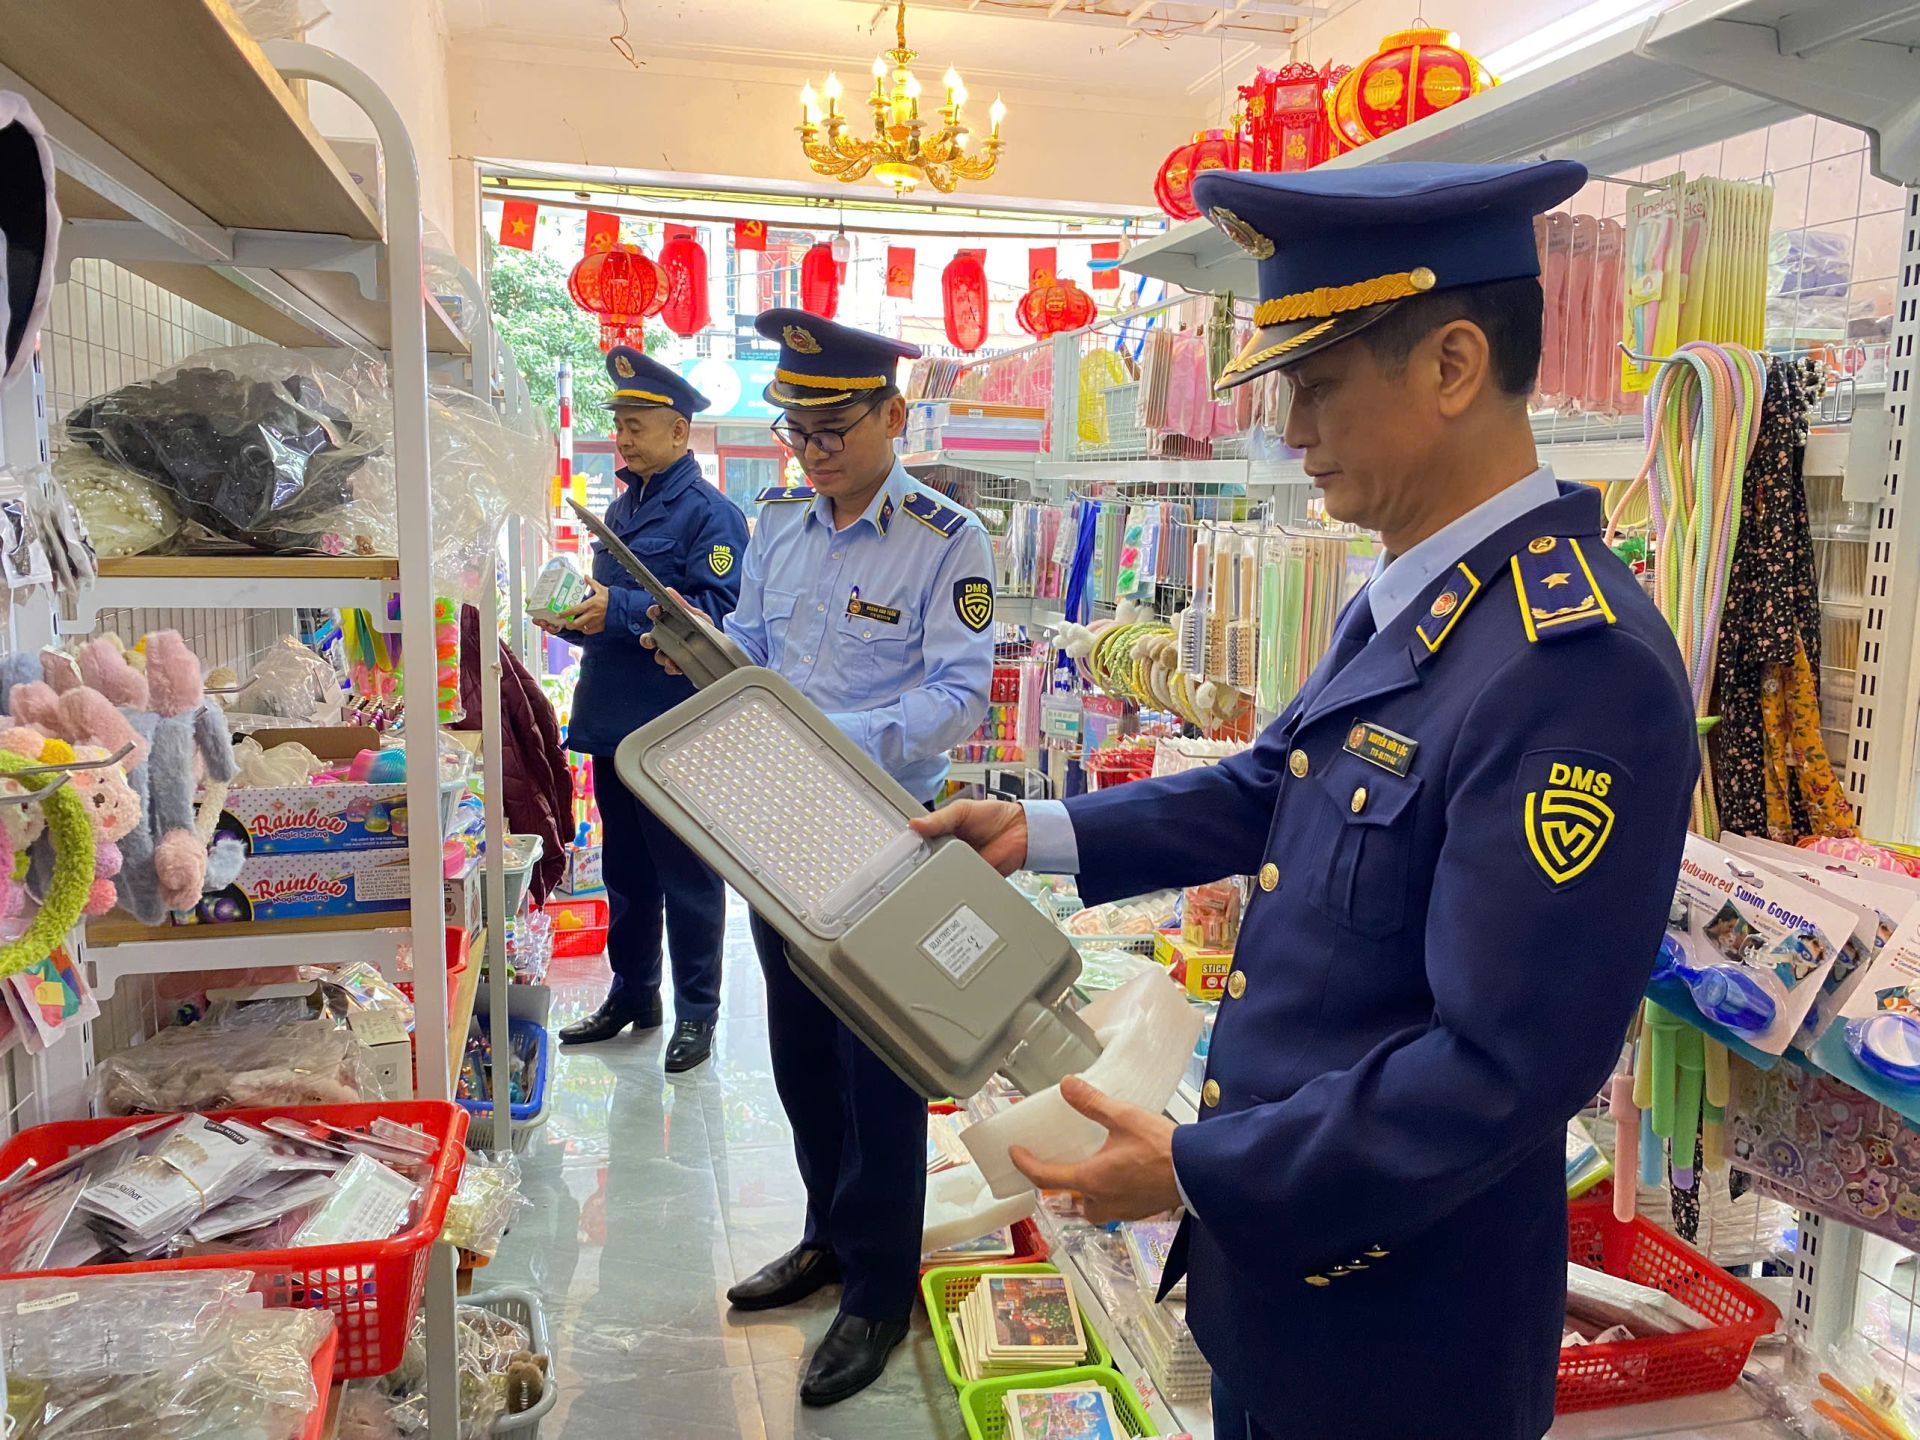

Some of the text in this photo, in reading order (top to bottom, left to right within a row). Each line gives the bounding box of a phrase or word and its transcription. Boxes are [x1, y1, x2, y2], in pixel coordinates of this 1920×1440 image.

[713, 544, 731, 554] DMS
[965, 583, 988, 594] DMS
[1549, 762, 1613, 796] DMS
[252, 807, 347, 836] Rainbow
[271, 829, 329, 840] Magic Spring
[254, 871, 347, 900] Rainbow
[272, 893, 329, 904] Magic Spring
[1680, 858, 1735, 894] Advanced
[1734, 884, 1766, 911] Swim
[1767, 901, 1817, 934] Goggles
[1202, 964, 1228, 974] STICK
